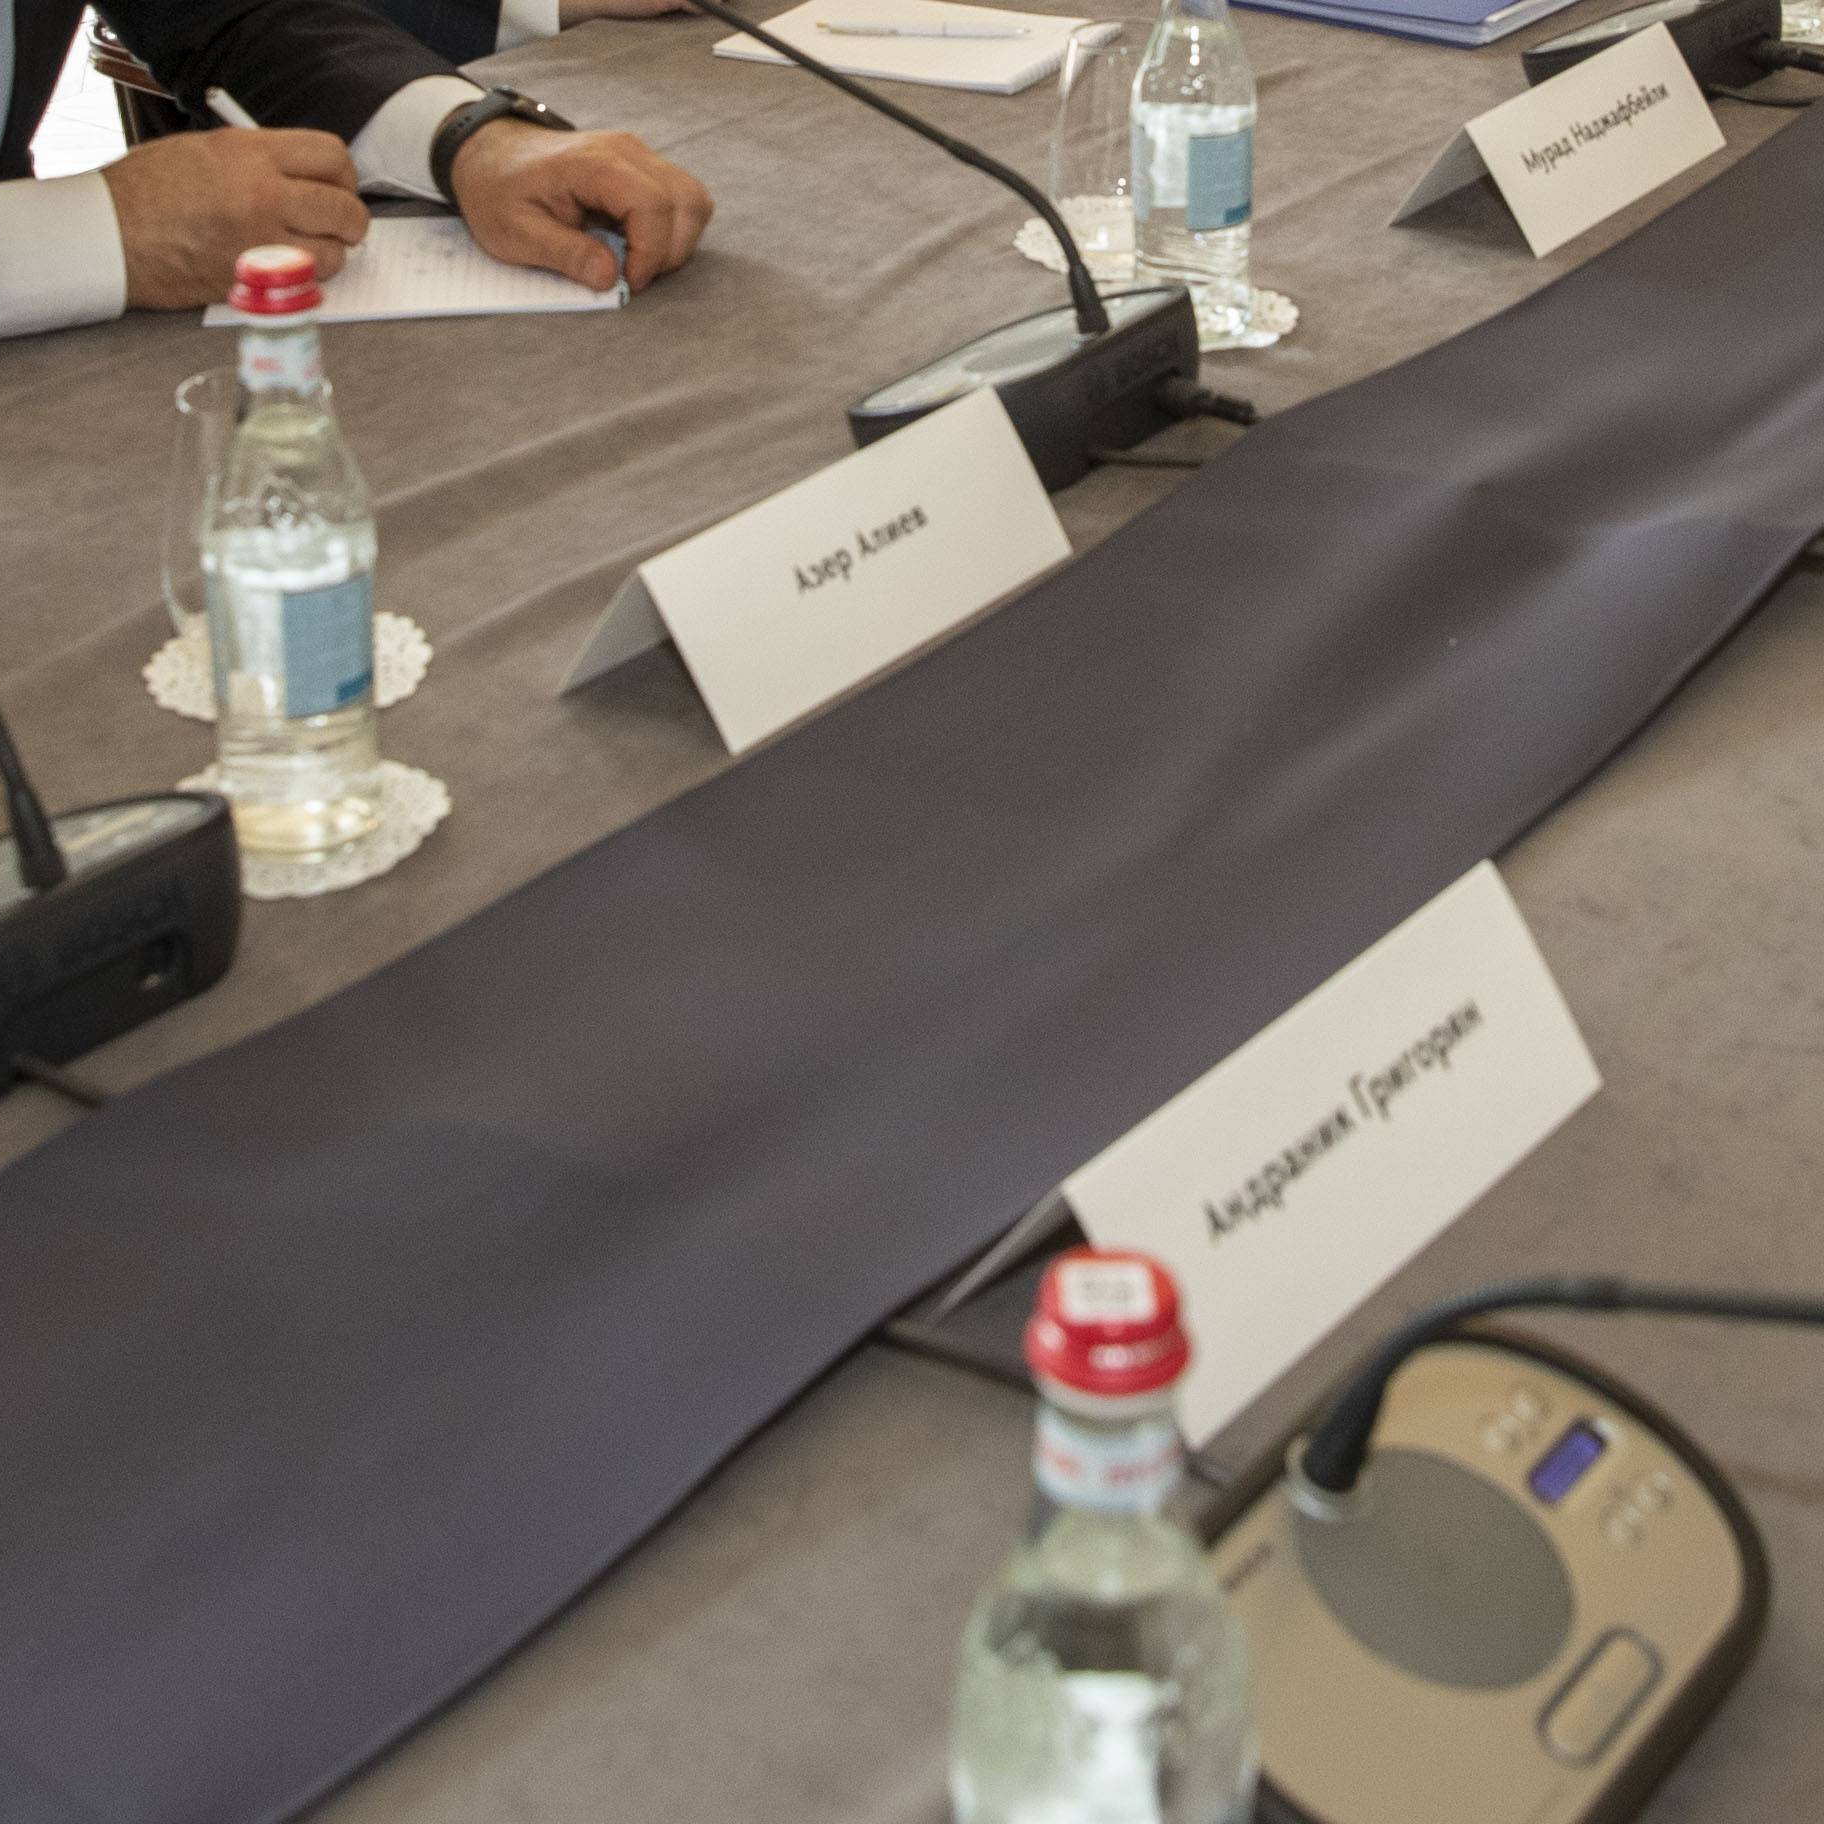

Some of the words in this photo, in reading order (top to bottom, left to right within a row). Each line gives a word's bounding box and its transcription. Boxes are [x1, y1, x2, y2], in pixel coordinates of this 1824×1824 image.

[1521, 137, 1575, 174] Мурад
[1569, 83, 1669, 147] Наджафбейли
[793, 547, 854, 596] Азер
[855, 504, 929, 559] Алиев
[1203, 1105, 1358, 1246] Андраник
[1347, 999, 1483, 1122] Григорян
